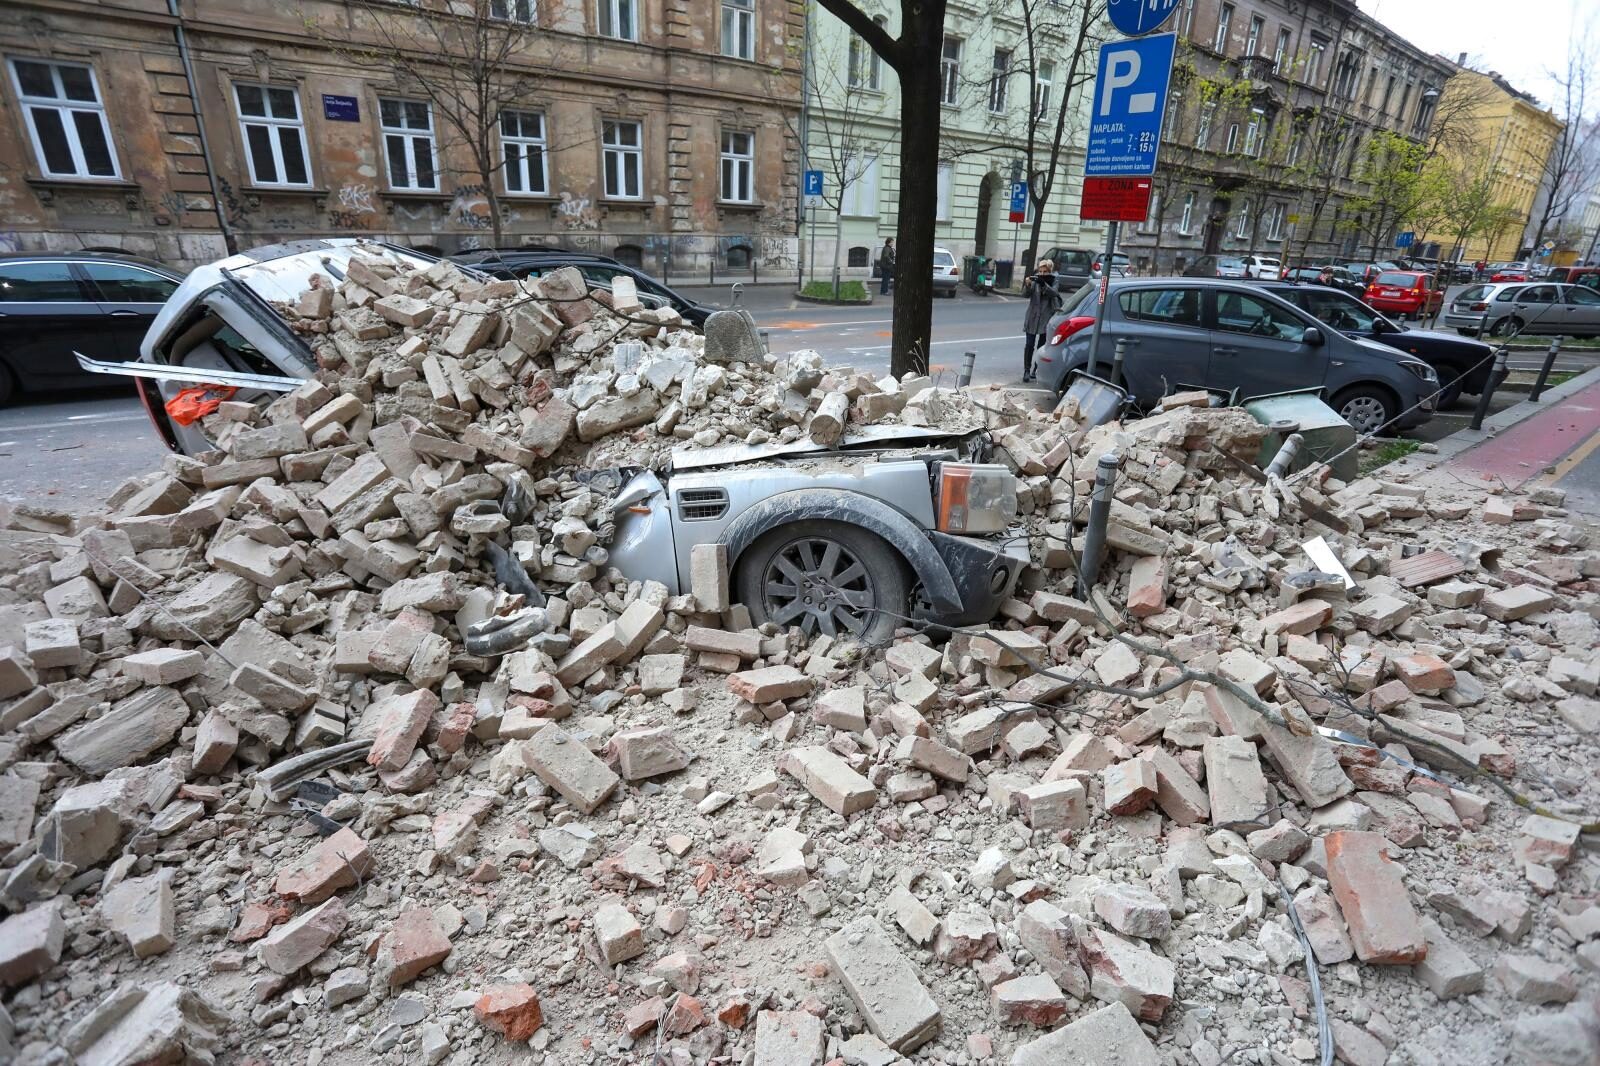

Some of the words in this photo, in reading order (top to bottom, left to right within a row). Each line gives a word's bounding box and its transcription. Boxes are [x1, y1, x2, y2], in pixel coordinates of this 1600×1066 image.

[1099, 49, 1142, 116] P
[1093, 123, 1126, 134] NAPLATA:
[1128, 134, 1134, 143] 7
[1140, 132, 1150, 142] 22
[1150, 132, 1156, 142] h
[1128, 144, 1132, 154] 7
[1139, 142, 1149, 153] 15
[1148, 144, 1154, 152] h
[809, 174, 818, 191] P
[1107, 180, 1134, 190] ZONA
[1012, 183, 1022, 199] P
